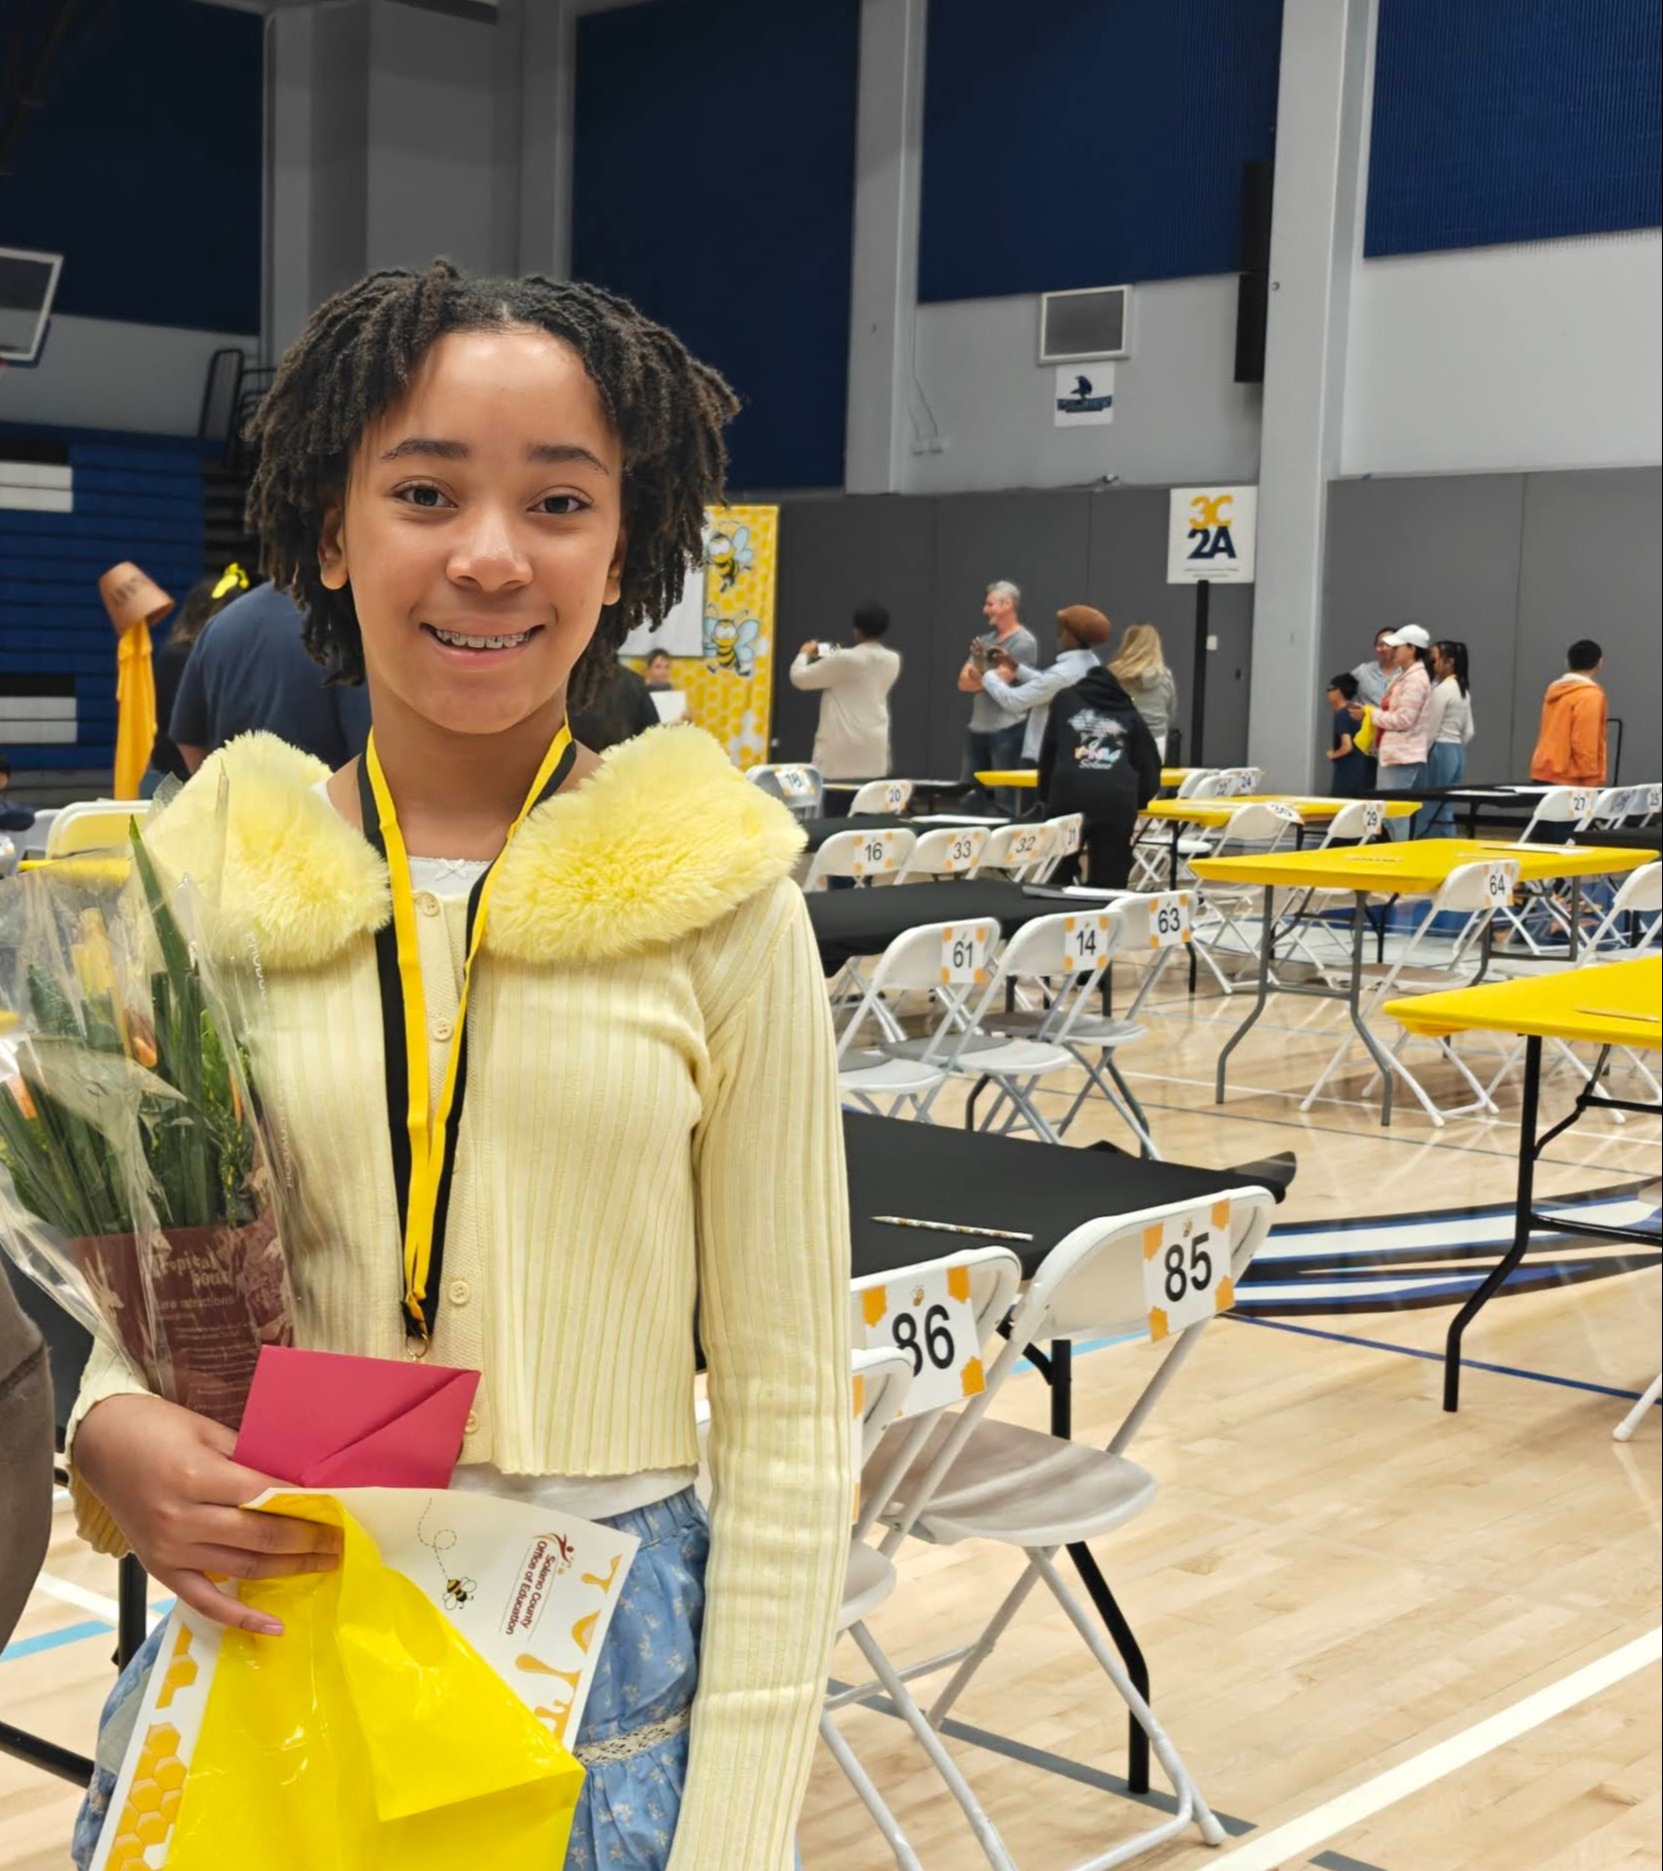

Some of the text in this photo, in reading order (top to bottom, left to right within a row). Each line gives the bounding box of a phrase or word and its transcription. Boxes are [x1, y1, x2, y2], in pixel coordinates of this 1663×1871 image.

[1189, 494, 1234, 530] 3C
[1187, 526, 1237, 560] 2A
[1367, 811, 1378, 826] 29
[1573, 799, 1586, 811] 27
[865, 842, 883, 862] 16
[953, 840, 972, 860] 33
[1016, 836, 1036, 853] 32
[1489, 875, 1506, 896] 64
[1158, 907, 1181, 934] 63
[952, 941, 973, 968] 61
[1076, 929, 1096, 956] 14
[1164, 1232, 1212, 1302] 85
[892, 1304, 955, 1378] 86
[506, 1540, 547, 1635] Office of Education
[520, 1554, 555, 1629] Solano County
